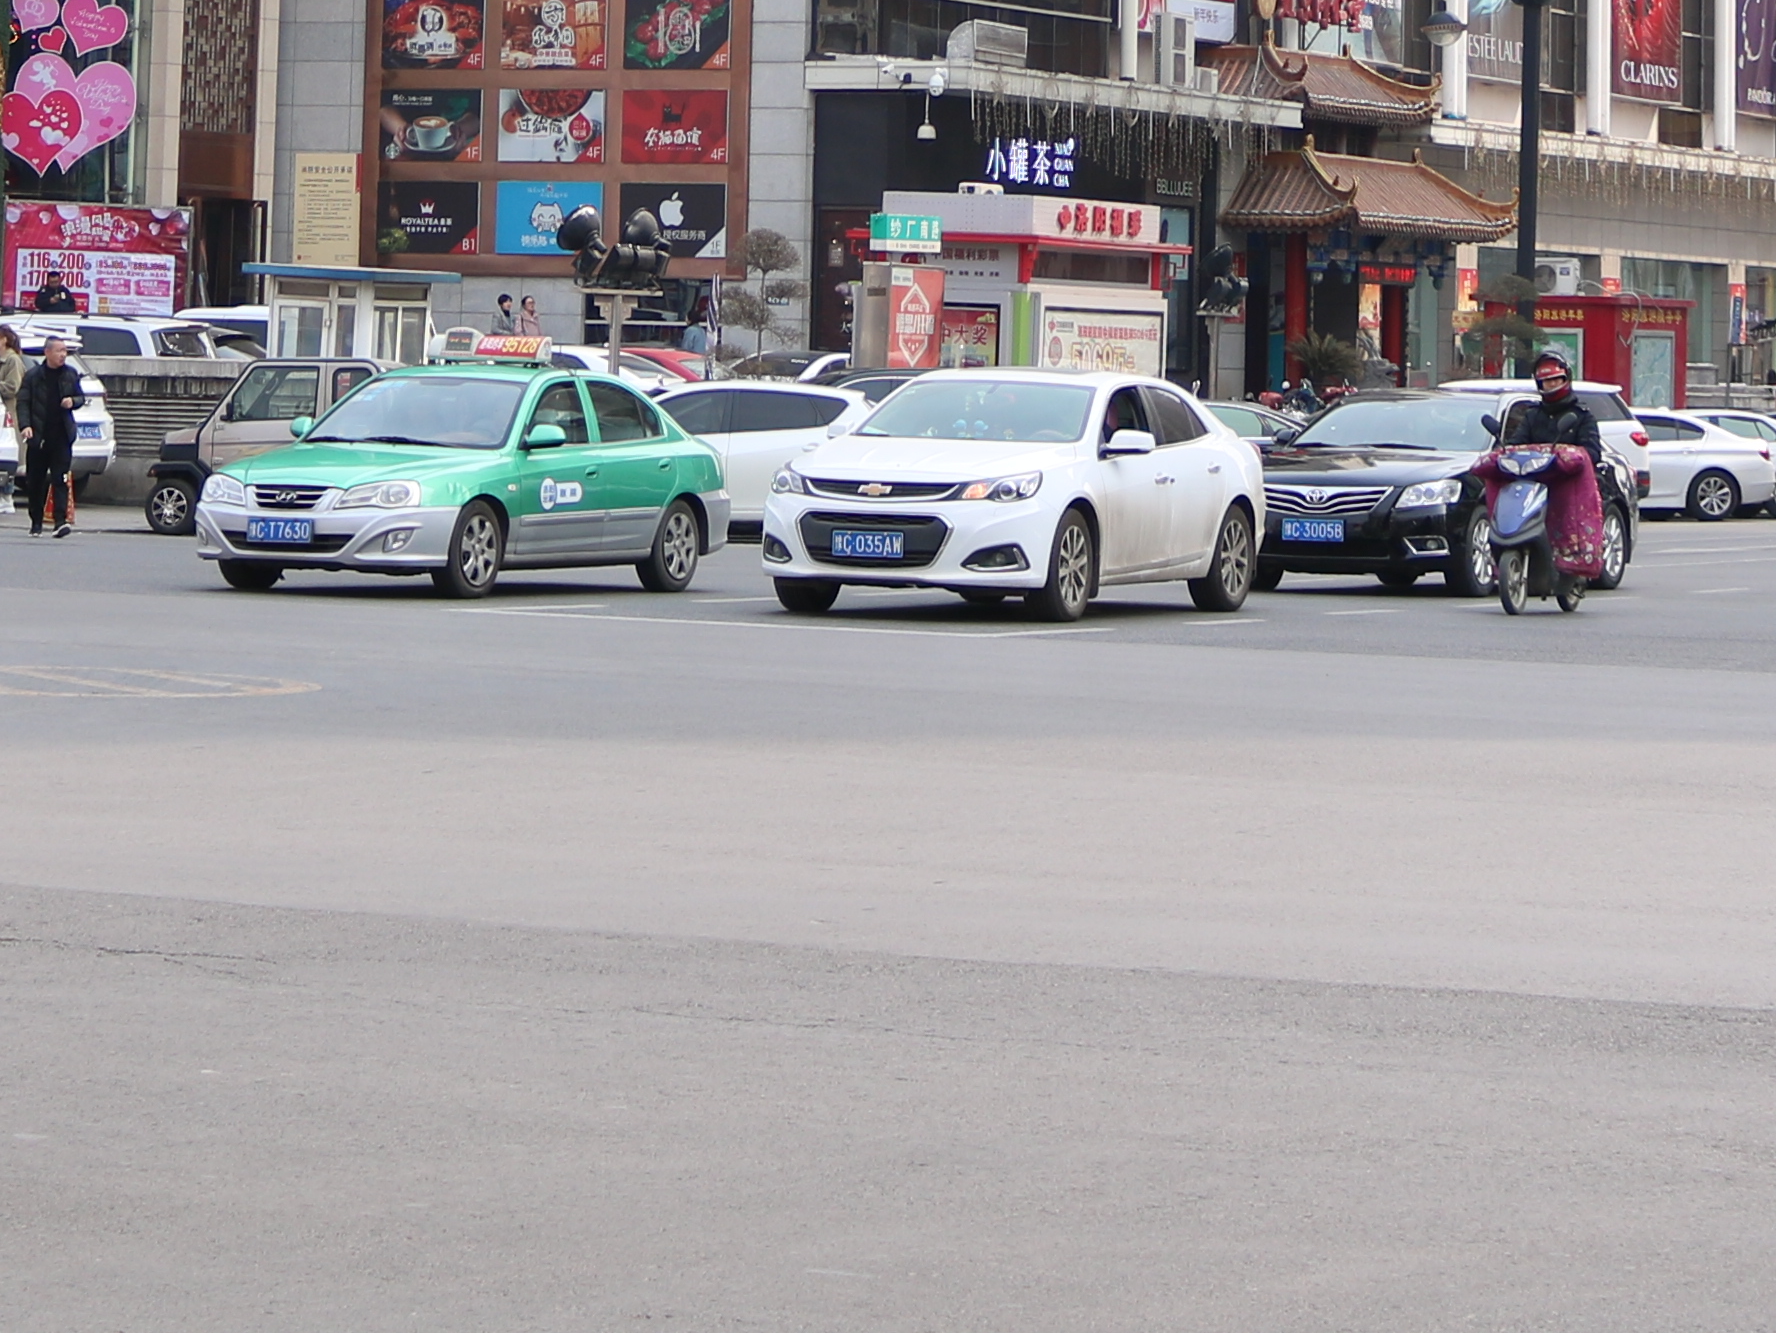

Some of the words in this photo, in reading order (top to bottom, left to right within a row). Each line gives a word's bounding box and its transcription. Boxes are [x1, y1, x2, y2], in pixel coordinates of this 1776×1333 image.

[467, 53, 482, 66] 4F
[589, 54, 603, 66] 4F
[713, 54, 727, 67] 4F
[1621, 59, 1678, 88] CLARINS
[466, 146, 479, 159] 1F
[586, 146, 601, 159] 4F
[710, 148, 725, 160] 4F
[986, 137, 1051, 185] 小罐茶
[1054, 160, 1073, 172] GUAN
[1053, 173, 1070, 188] CHA
[890, 218, 940, 239] 纱厂南路
[663, 229, 707, 242] 授权服务商
[462, 238, 475, 251] B1
[711, 240, 722, 249] 1F
[28, 251, 51, 268] 116
[58, 252, 85, 269] 200
[28, 270, 48, 286] 170
[502, 337, 540, 353] 95128
